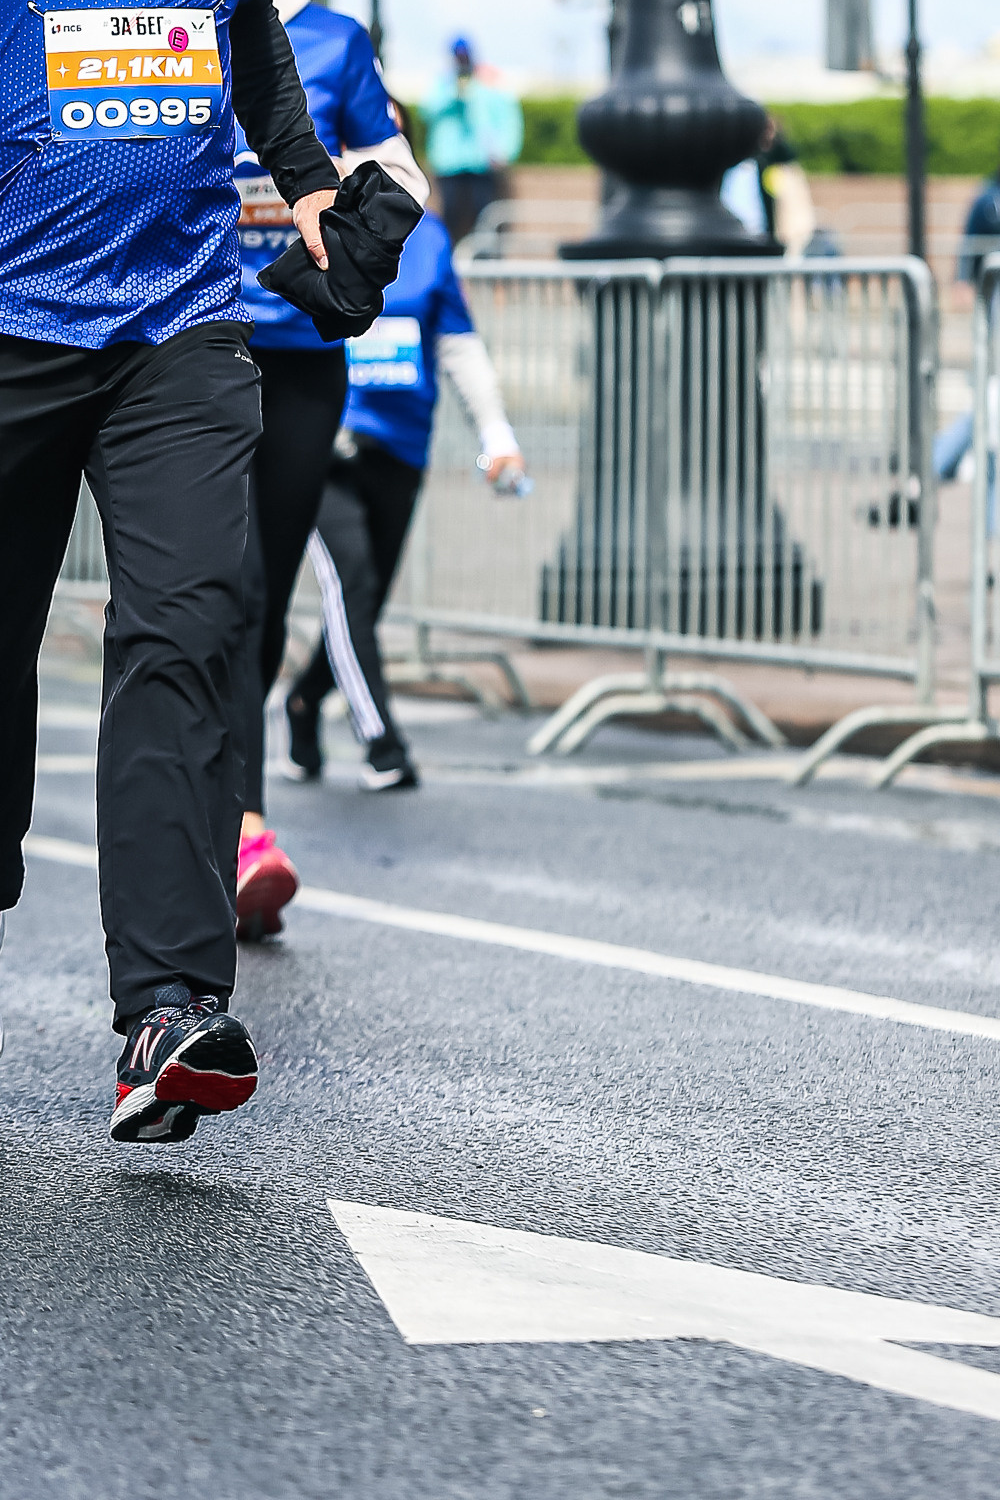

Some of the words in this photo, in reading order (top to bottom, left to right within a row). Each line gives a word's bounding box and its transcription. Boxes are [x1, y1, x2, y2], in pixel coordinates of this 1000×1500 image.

[63, 24, 82, 32] ПСБ
[61, 97, 212, 130] 00995
[129, 1025, 167, 1072] N
